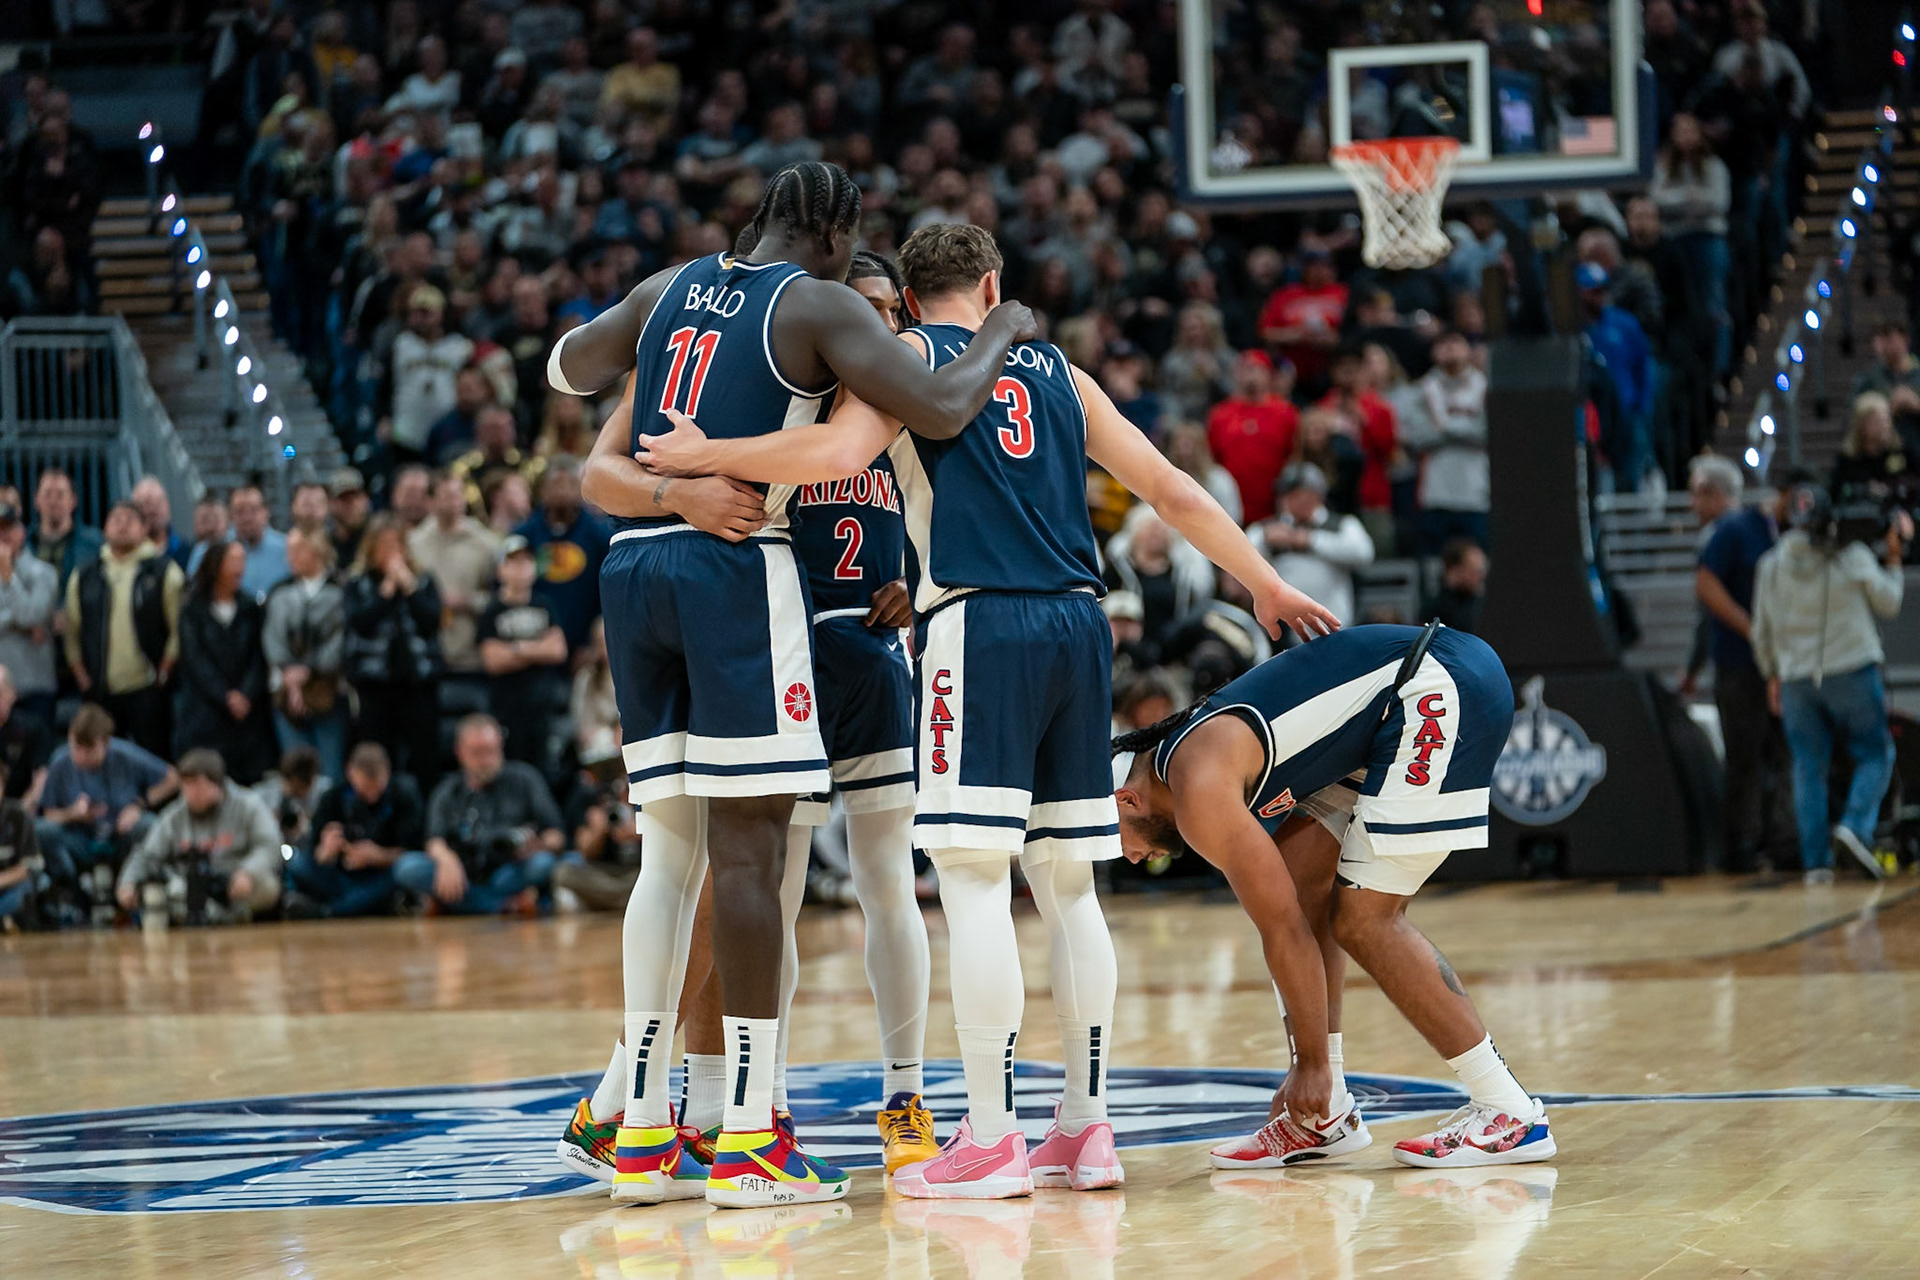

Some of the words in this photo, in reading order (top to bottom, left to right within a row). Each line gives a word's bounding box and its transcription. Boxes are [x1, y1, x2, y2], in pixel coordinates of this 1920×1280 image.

[658, 325, 722, 419] 11
[993, 376, 1035, 459] 3
[834, 517, 863, 580] 2
[930, 669, 954, 775] CATS
[1405, 693, 1447, 786] CATS
[740, 1176, 775, 1192] FAITH
